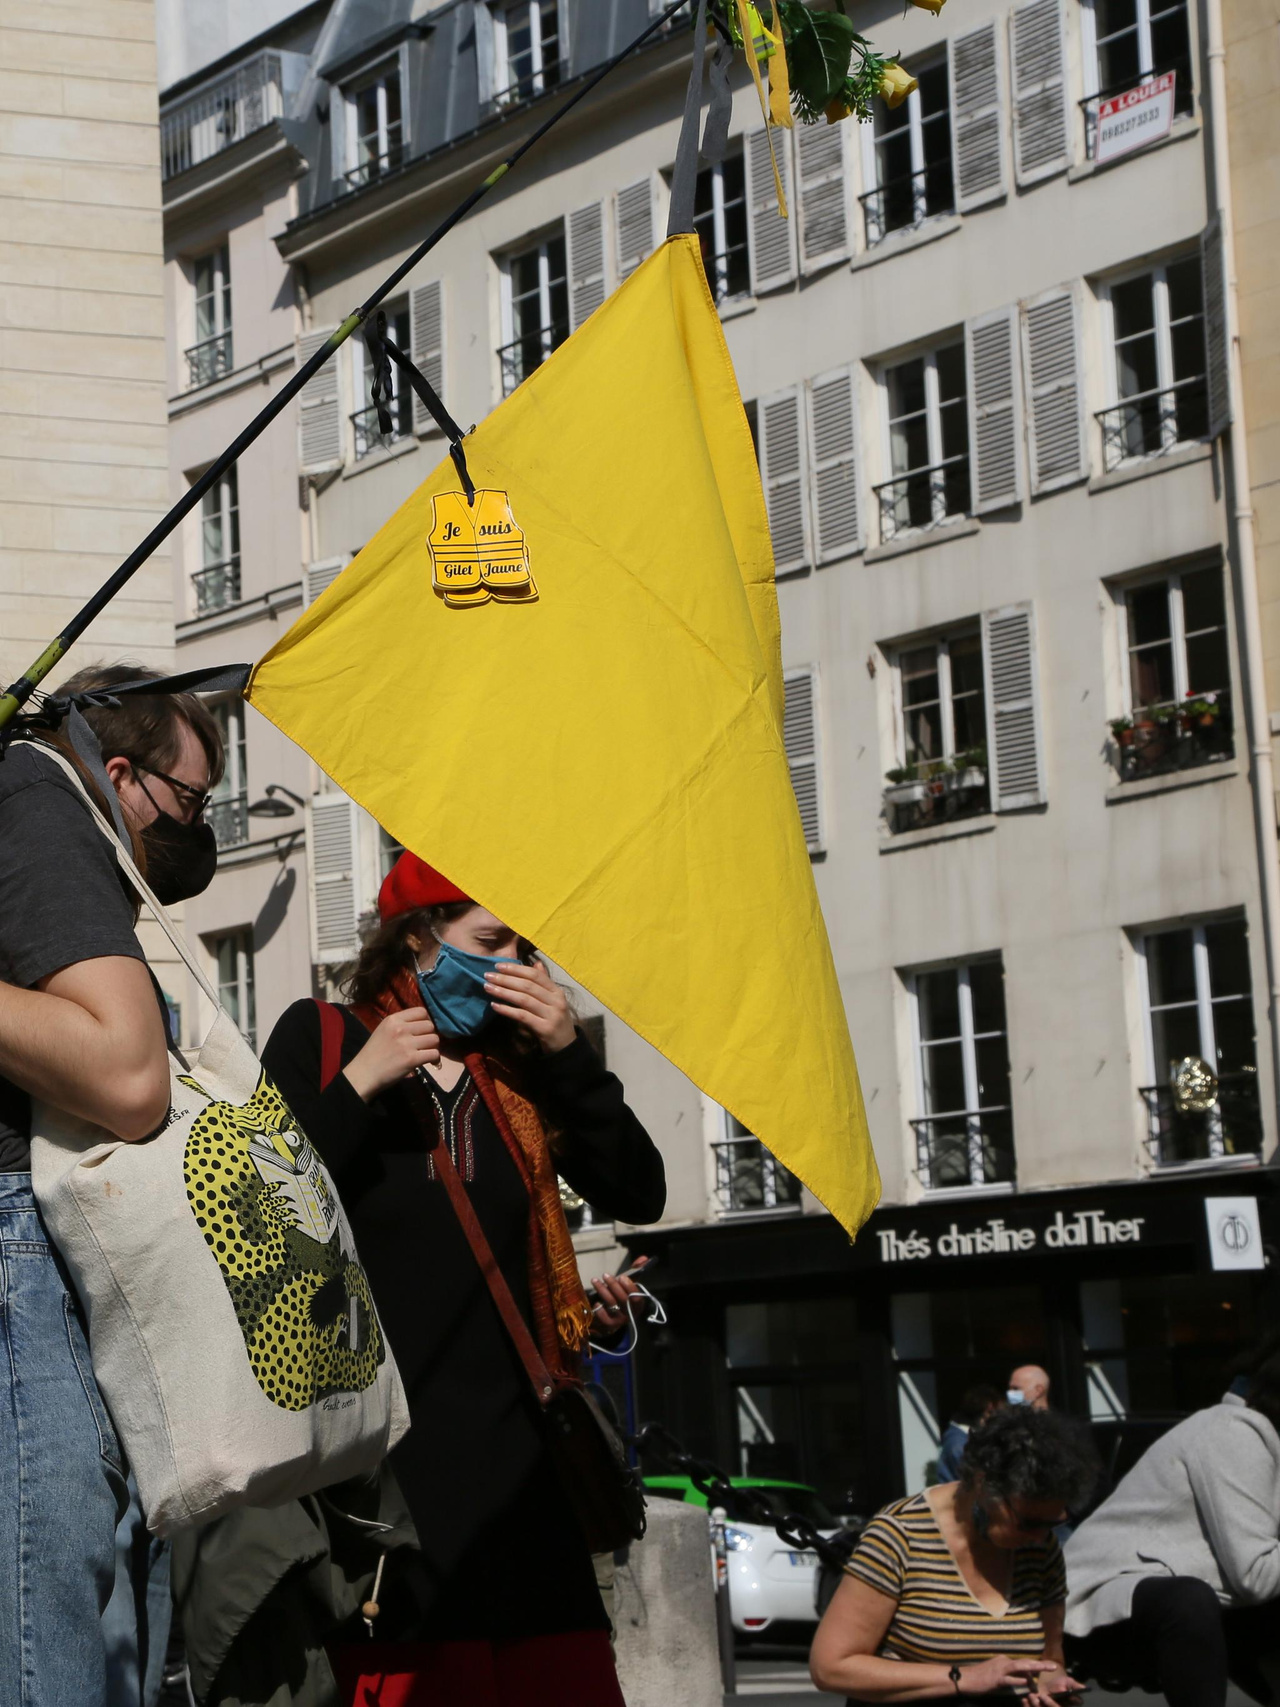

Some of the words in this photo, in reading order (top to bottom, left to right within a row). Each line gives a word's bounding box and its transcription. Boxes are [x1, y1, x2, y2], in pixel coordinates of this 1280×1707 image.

[1102, 103, 1114, 116] A
[1117, 76, 1170, 109] LOUER
[442, 521, 462, 541] Je
[478, 520, 512, 536] suis
[443, 564, 474, 578] Gilet
[483, 562, 523, 578] Jaune
[876, 1230, 931, 1262] Thés
